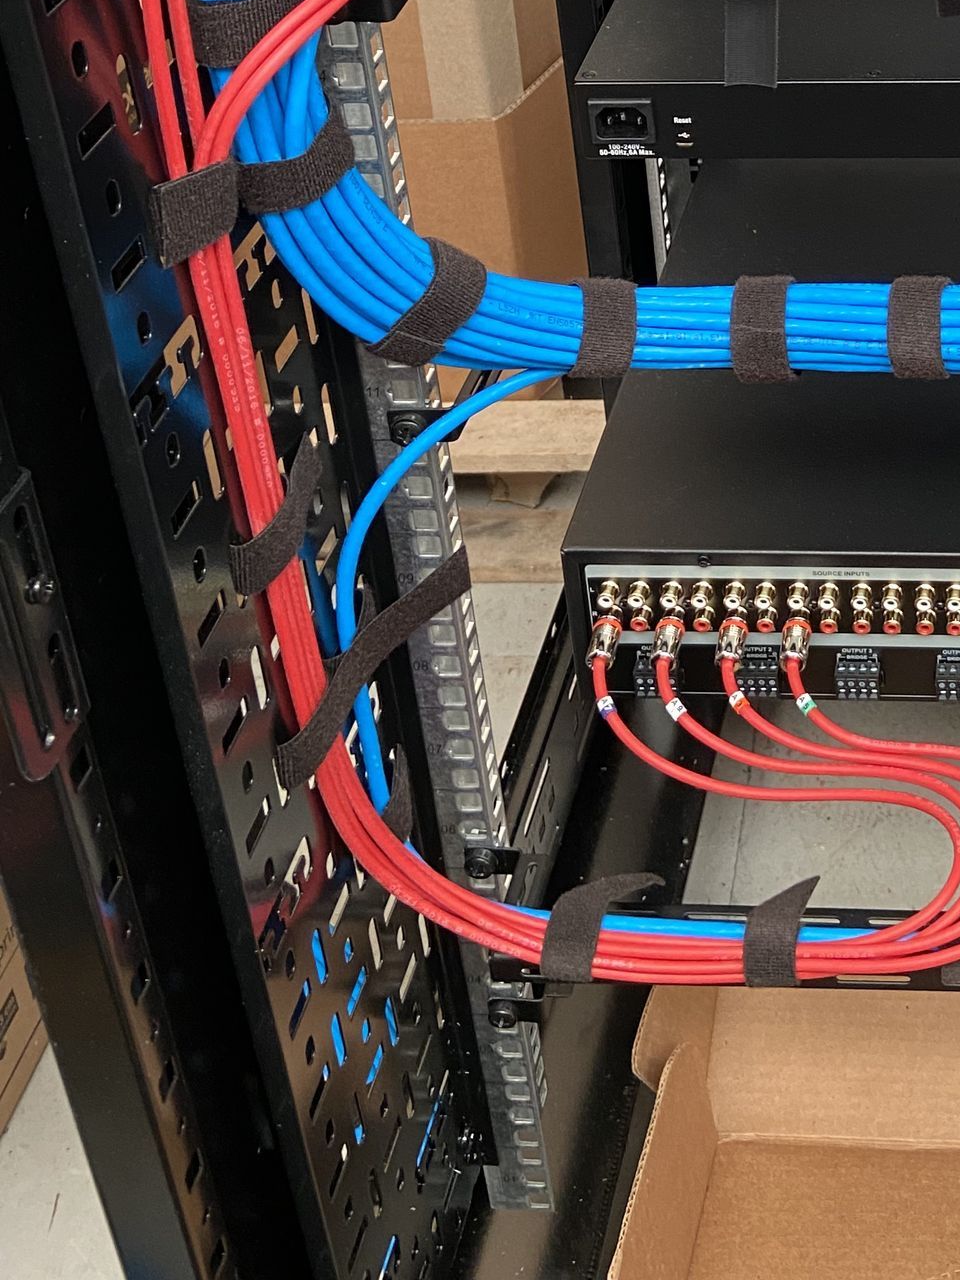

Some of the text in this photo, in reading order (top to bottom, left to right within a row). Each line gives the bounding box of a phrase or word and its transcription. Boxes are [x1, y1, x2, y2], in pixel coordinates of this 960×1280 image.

[673, 116, 690, 124] Reset
[399, 572, 415, 584] 09
[812, 569, 871, 578] SOURCE INPUTS
[413, 659, 430, 672] 08
